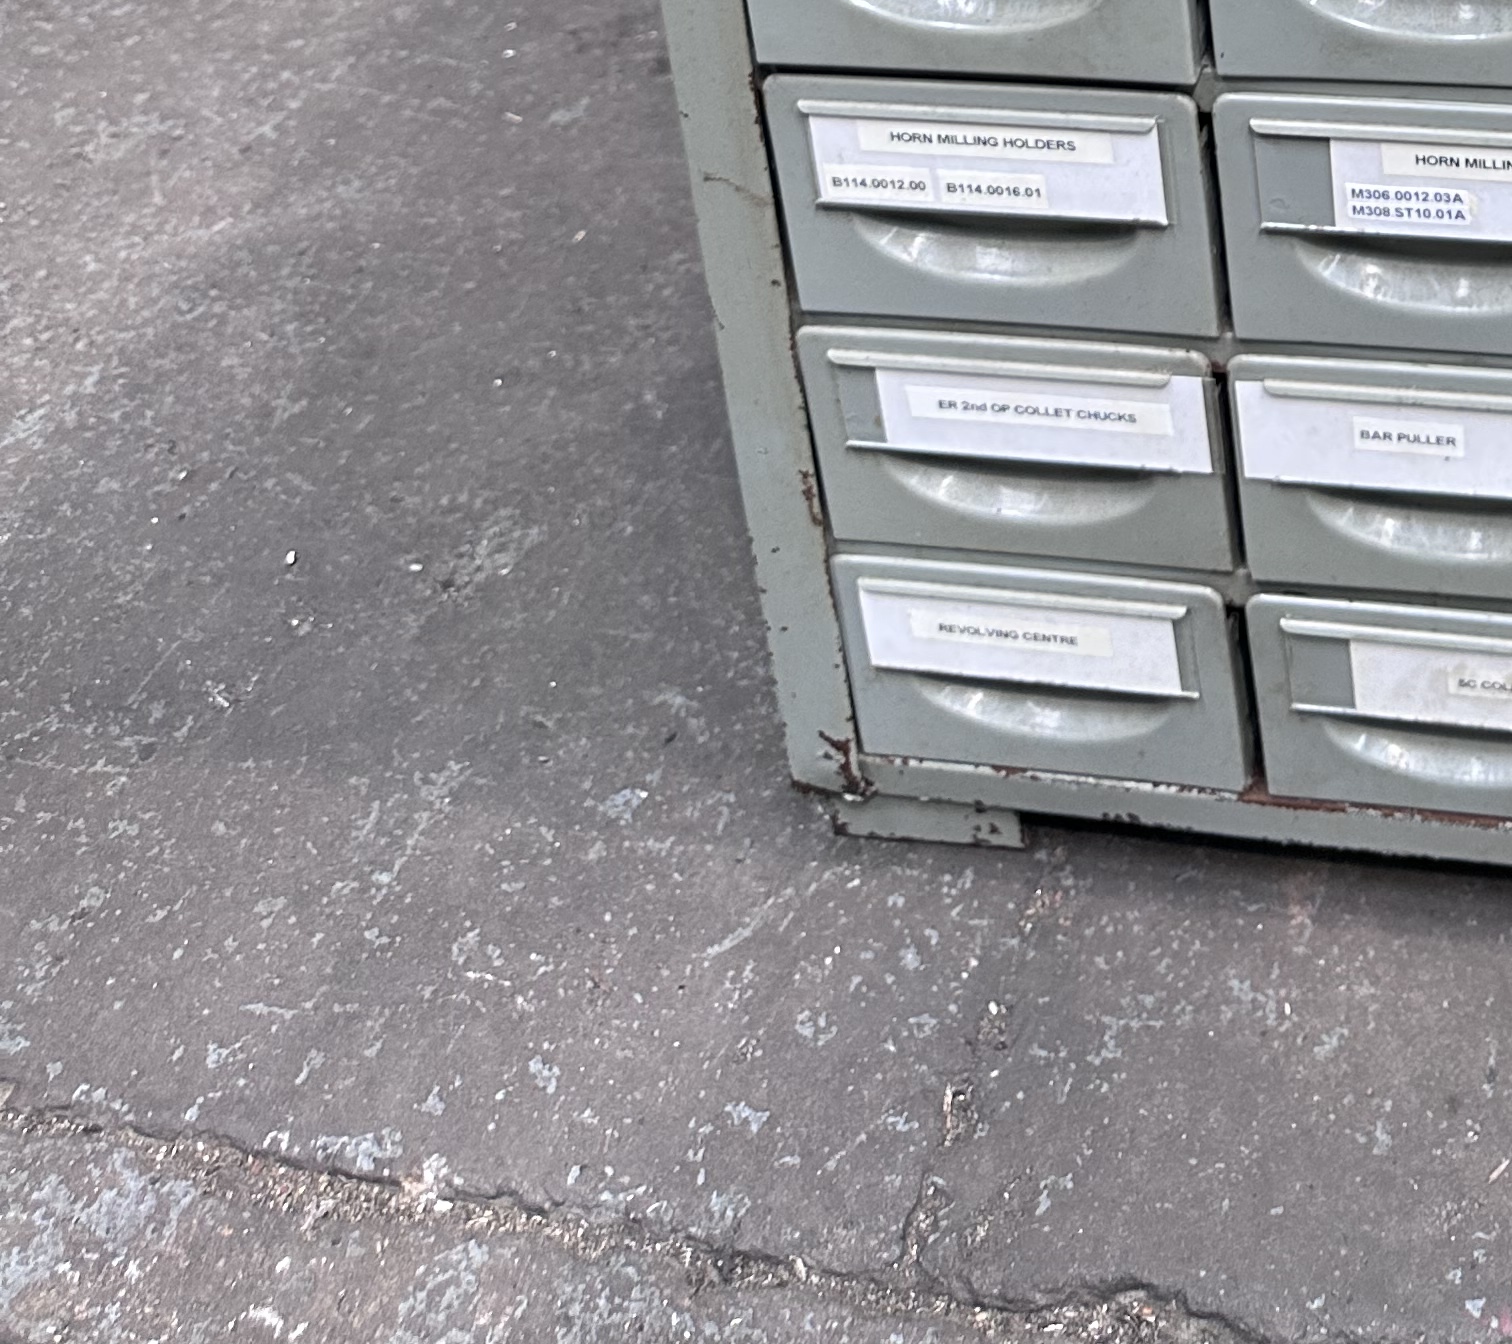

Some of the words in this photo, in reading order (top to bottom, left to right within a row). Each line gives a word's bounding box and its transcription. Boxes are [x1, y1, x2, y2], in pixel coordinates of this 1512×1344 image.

[889, 131, 934, 145] HORN
[936, 134, 999, 148] MILLING
[1002, 136, 1077, 152] HOLDERS
[1414, 154, 1461, 169] HORN
[938, 399, 958, 410] ER
[961, 400, 988, 412] 2nd
[990, 402, 1011, 414] OP
[1014, 404, 1073, 419] COLLET
[1076, 408, 1138, 424] CHUCKS
[1359, 429, 1393, 441] BAR
[1396, 432, 1457, 447] PULLER
[938, 622, 1020, 641] REVOLVING
[1022, 631, 1079, 646] CENTRE
